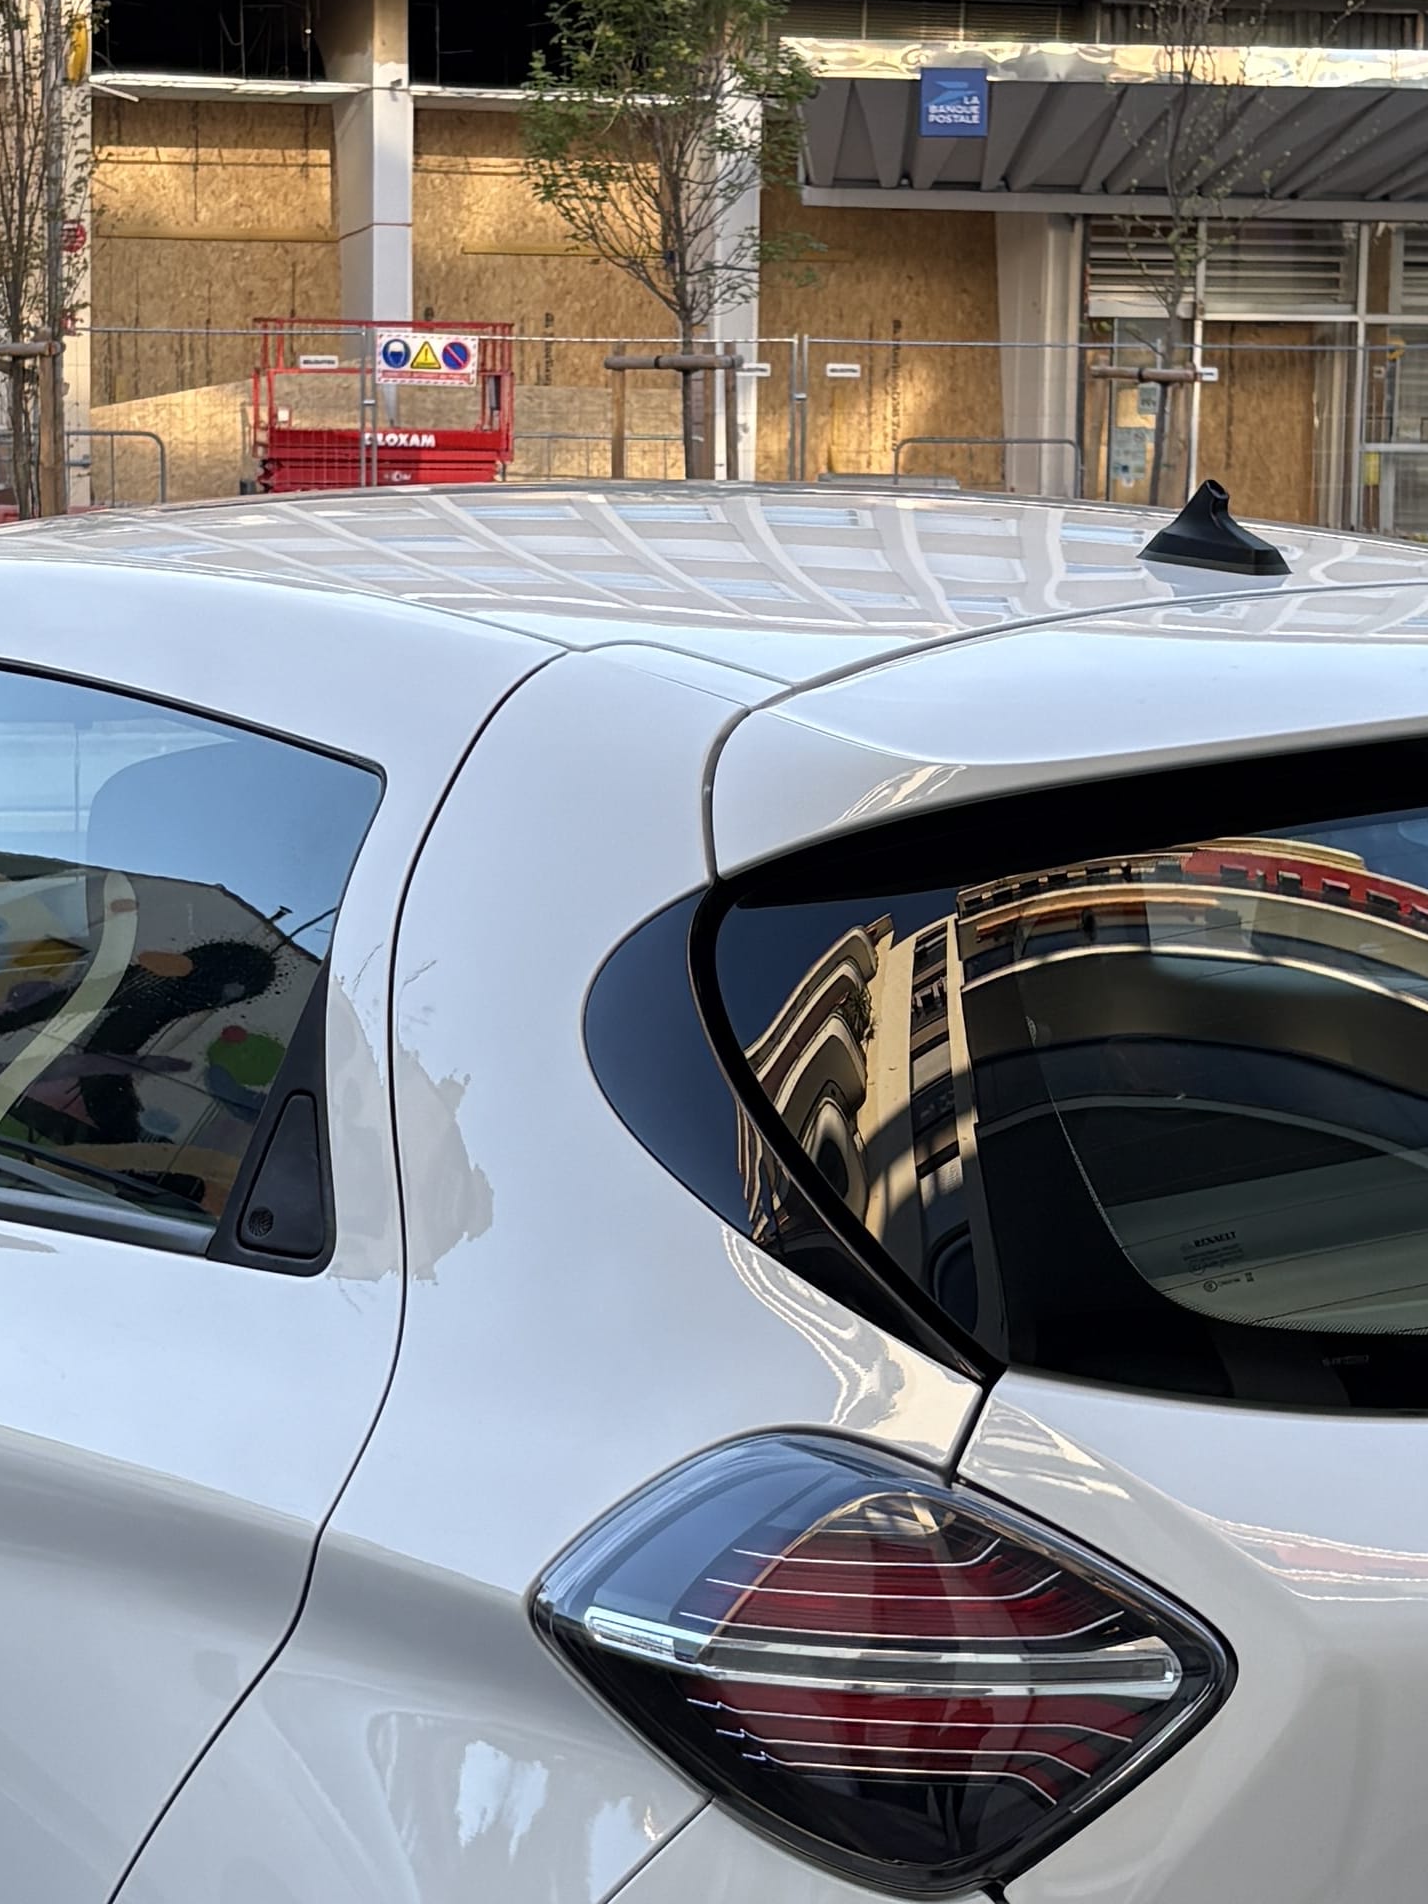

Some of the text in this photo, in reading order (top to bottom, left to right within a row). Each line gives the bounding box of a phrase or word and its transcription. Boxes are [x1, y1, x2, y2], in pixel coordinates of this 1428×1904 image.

[963, 96, 980, 105] LA
[928, 104, 980, 114] BANQUE
[928, 114, 980, 124] POSTALE
